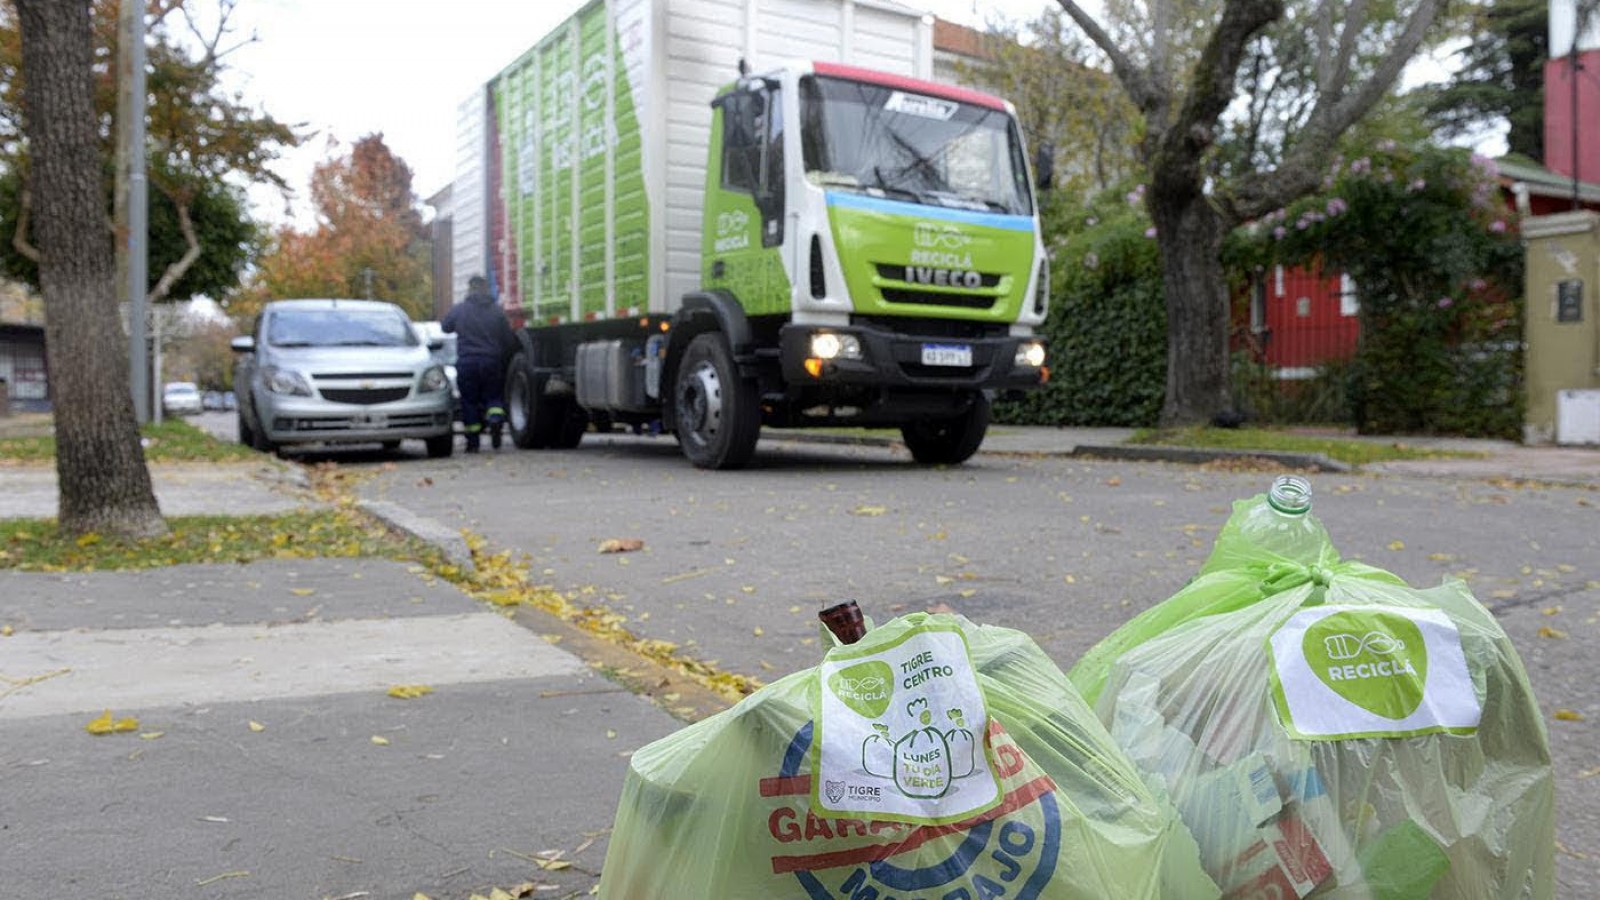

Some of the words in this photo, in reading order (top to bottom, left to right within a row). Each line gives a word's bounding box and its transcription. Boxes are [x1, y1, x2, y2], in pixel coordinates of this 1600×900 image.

[905, 266, 982, 288] IVECO
[901, 651, 933, 674] TIGRE
[1327, 658, 1417, 680] RECICLÁ
[903, 665, 953, 689] CENTRO
[903, 748, 940, 763] LUNES
[848, 785, 881, 796] TIGRE
[903, 776, 944, 788] VERDE
